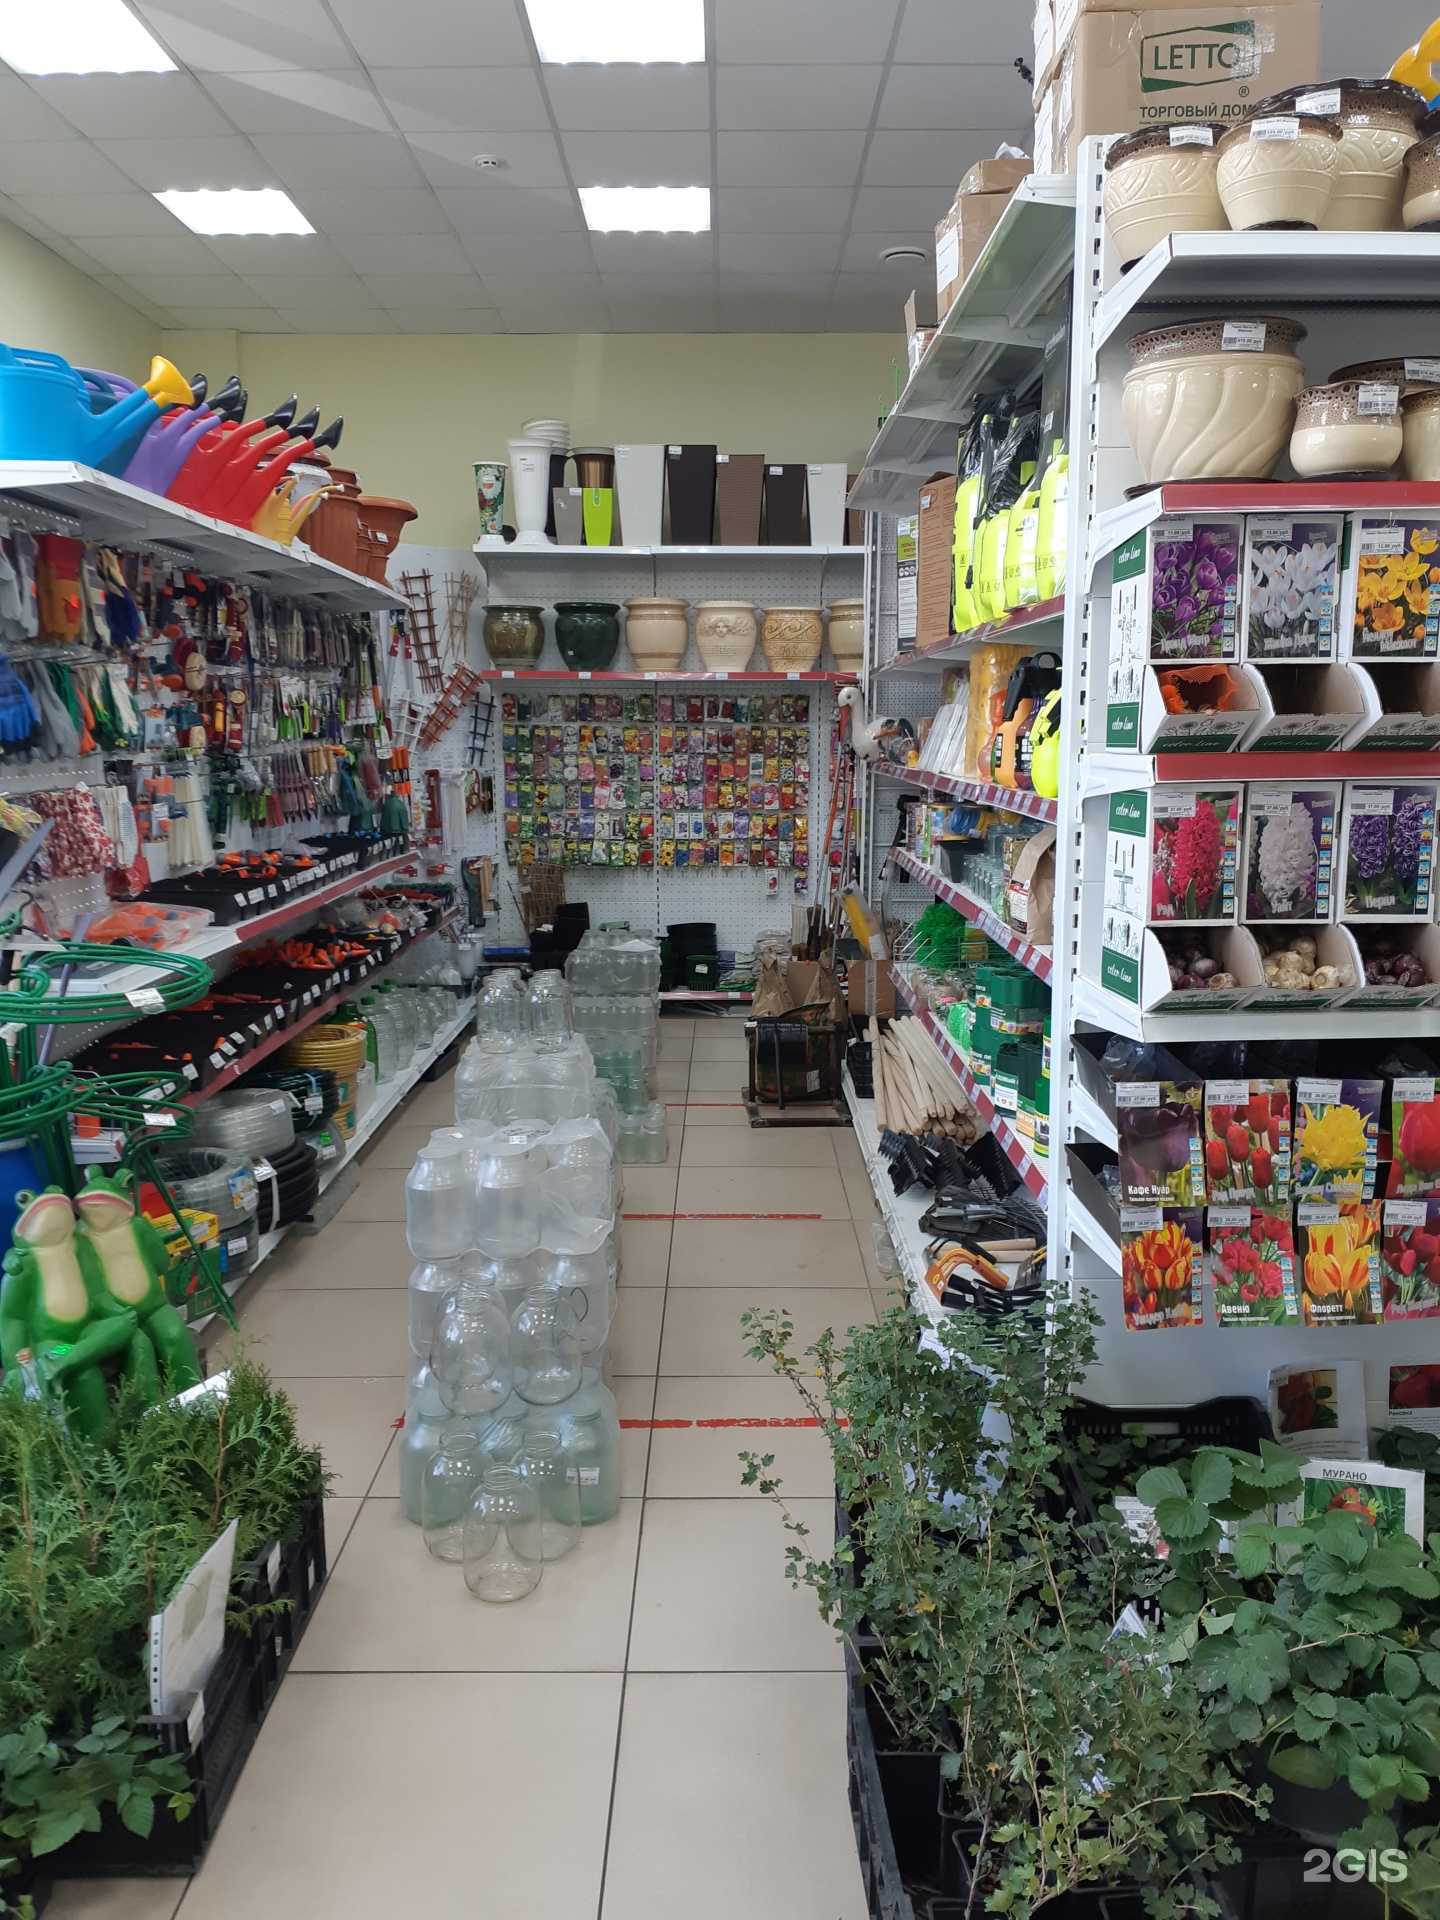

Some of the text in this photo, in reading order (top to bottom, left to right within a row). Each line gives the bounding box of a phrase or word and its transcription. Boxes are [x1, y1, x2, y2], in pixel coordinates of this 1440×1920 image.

[1153, 43, 1241, 70] LETTO
[1139, 102, 1217, 119] ТОРГОВЫЙ
[1128, 1184, 1170, 1196] Кафе Нуар
[1221, 1303, 1250, 1314] Авеню
[1310, 1303, 1344, 1313] Флоретт
[1322, 1468, 1368, 1481] МУРАНО
